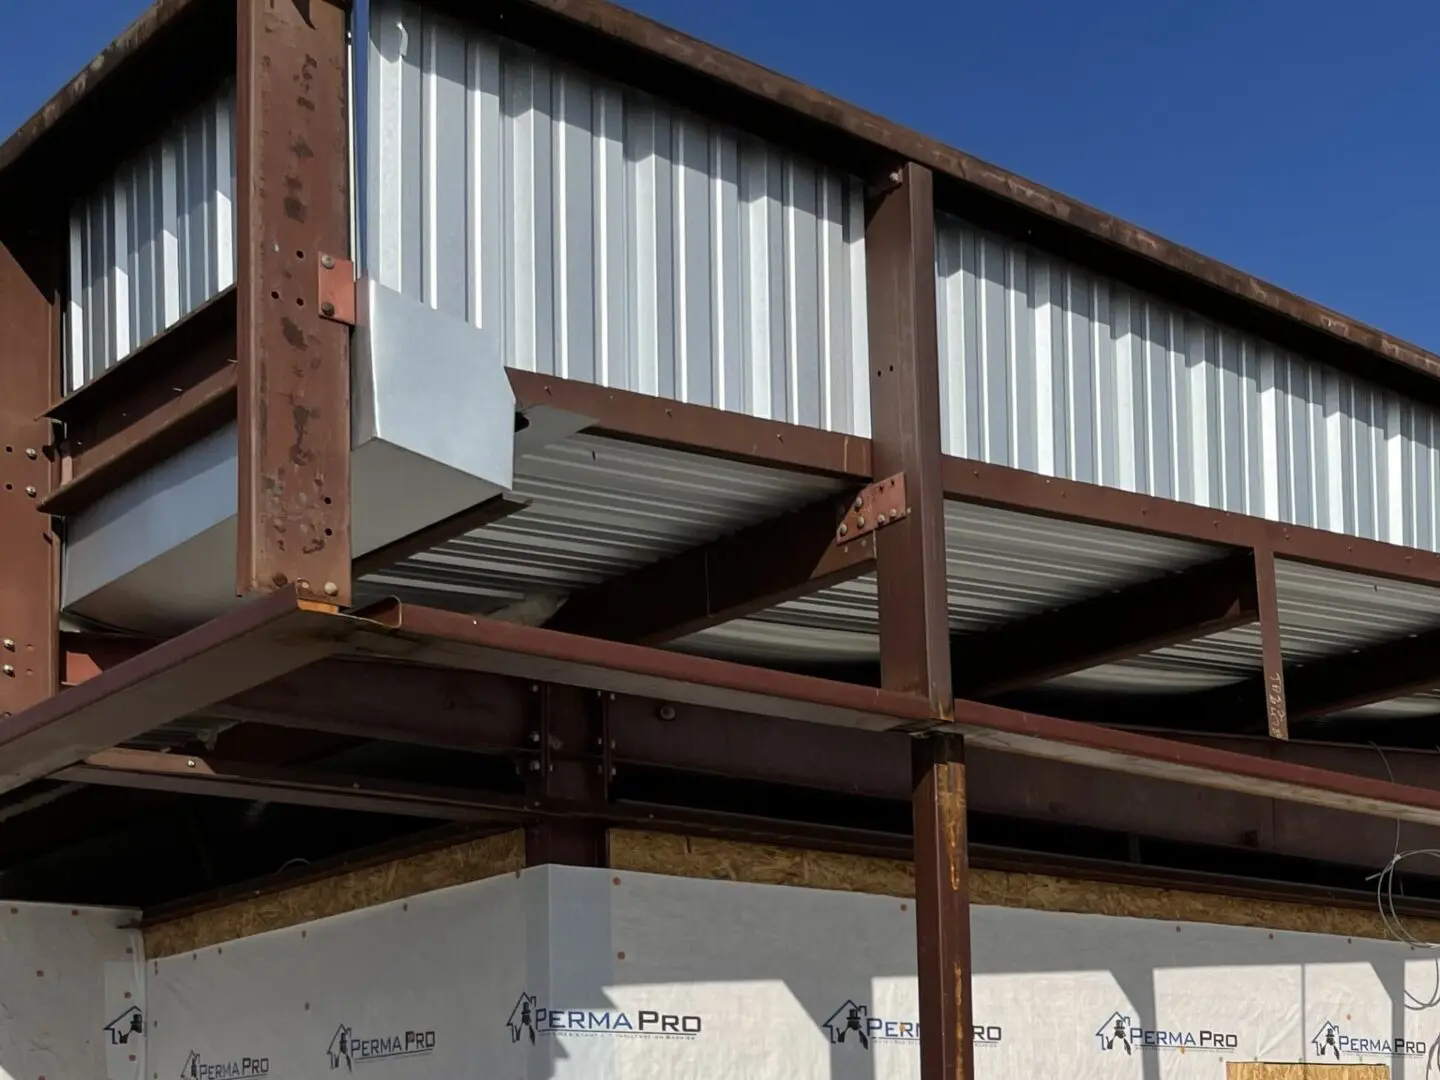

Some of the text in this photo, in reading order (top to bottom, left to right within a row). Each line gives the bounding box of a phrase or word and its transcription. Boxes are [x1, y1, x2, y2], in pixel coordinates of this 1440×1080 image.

[535, 1008, 701, 1034] PERMA PRO
[867, 1018, 1002, 1041] PER RO
[351, 1031, 435, 1058] PERMA PRO
[1130, 1028, 1237, 1048] PERMA PRO
[1339, 1036, 1426, 1054] PERMA PRO
[200, 1057, 269, 1080] PERMA PRO
